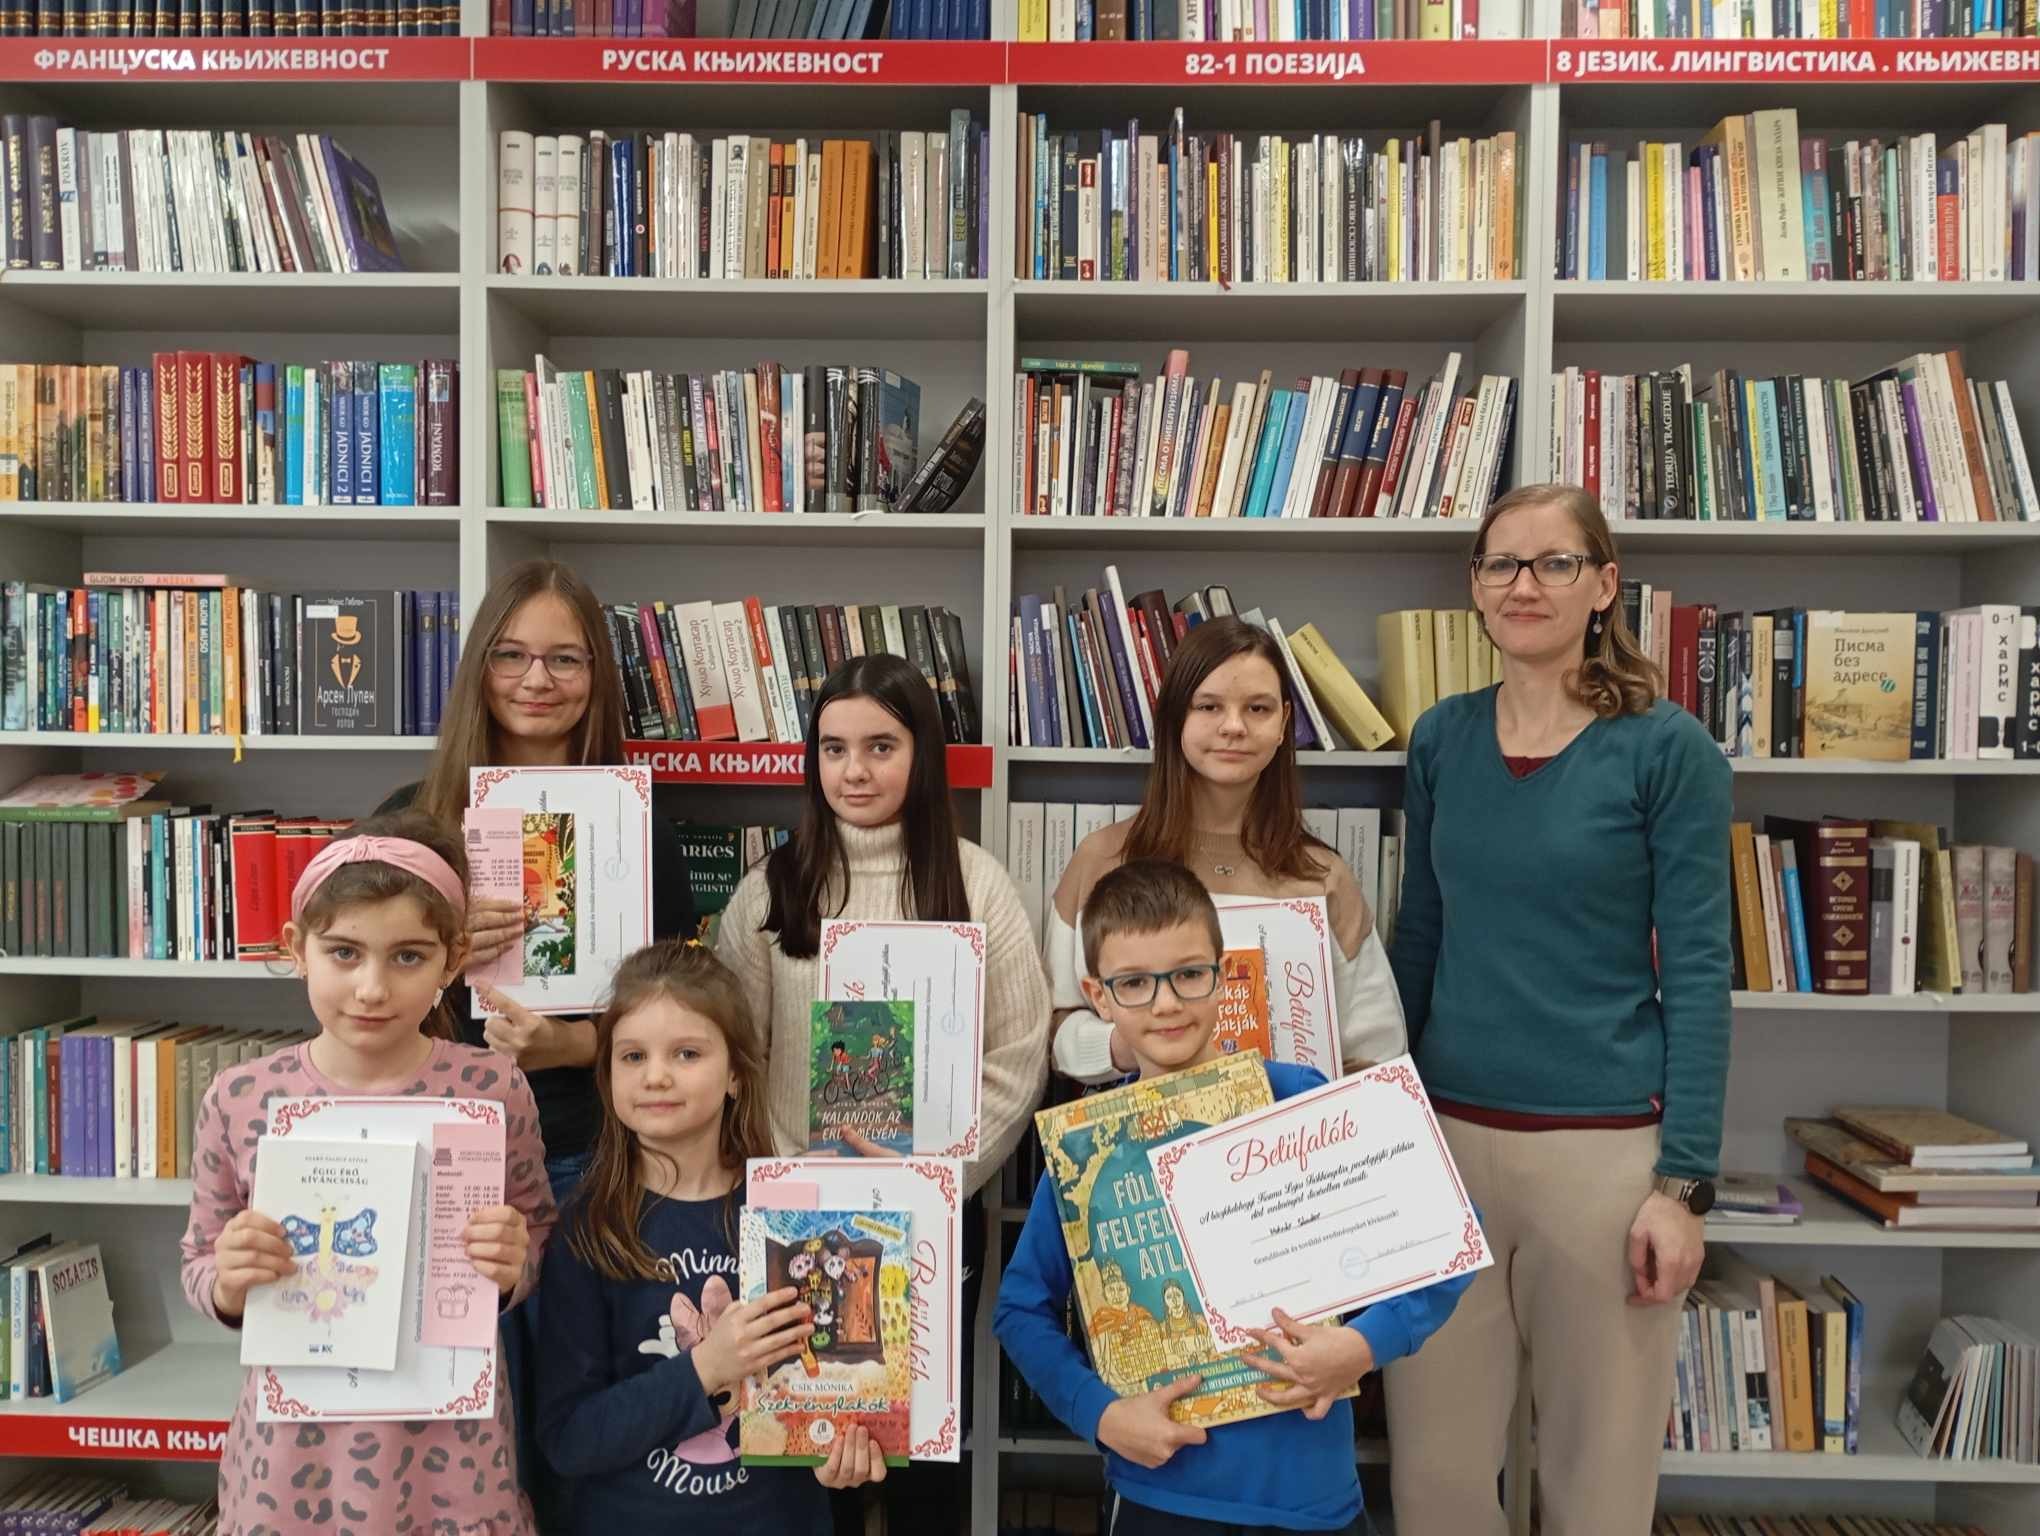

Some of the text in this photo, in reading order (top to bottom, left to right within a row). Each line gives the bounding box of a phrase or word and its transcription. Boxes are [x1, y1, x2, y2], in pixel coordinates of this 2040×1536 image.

[34, 48, 389, 74] ФРАНЦУСКА КЊИЖЕВНОСТ
[603, 50, 883, 73] РУСКА КЊИЖЕВНОСТ
[1185, 53, 1365, 78] 82-1 ПОЕЗИЈА
[1557, 54, 1572, 71] 8
[1671, 51, 1872, 73] ЛИНГВИСТИКА
[1662, 389, 1676, 490] TEORIJA TRAGEDIJE
[337, 431, 348, 494] JADNICI 2
[361, 431, 372, 483] JADNICI
[689, 619, 706, 665] Кортасар
[723, 619, 739, 666] Кортасар
[1834, 638, 1886, 653] Писма
[1698, 637, 1716, 684] EKO
[1834, 652, 1861, 668] без
[1832, 669, 1888, 686] адресе
[317, 685, 375, 706] Арсен Лупен
[821, 1109, 903, 1125] KALANDOK AZ
[1226, 1110, 1358, 1182] Belüfalók
[301, 1175, 369, 1186] KÍVÁNCSISÁG
[312, 1166, 337, 1177] ÉGIG
[1113, 1171, 1163, 1209] FÖL
[791, 1381, 854, 1393] CSÍK MÓNIKA
[757, 1395, 890, 1420] Szekrénylakók
[68, 1426, 160, 1450] ЧЕШКА
[647, 1448, 749, 1496] Mouse
